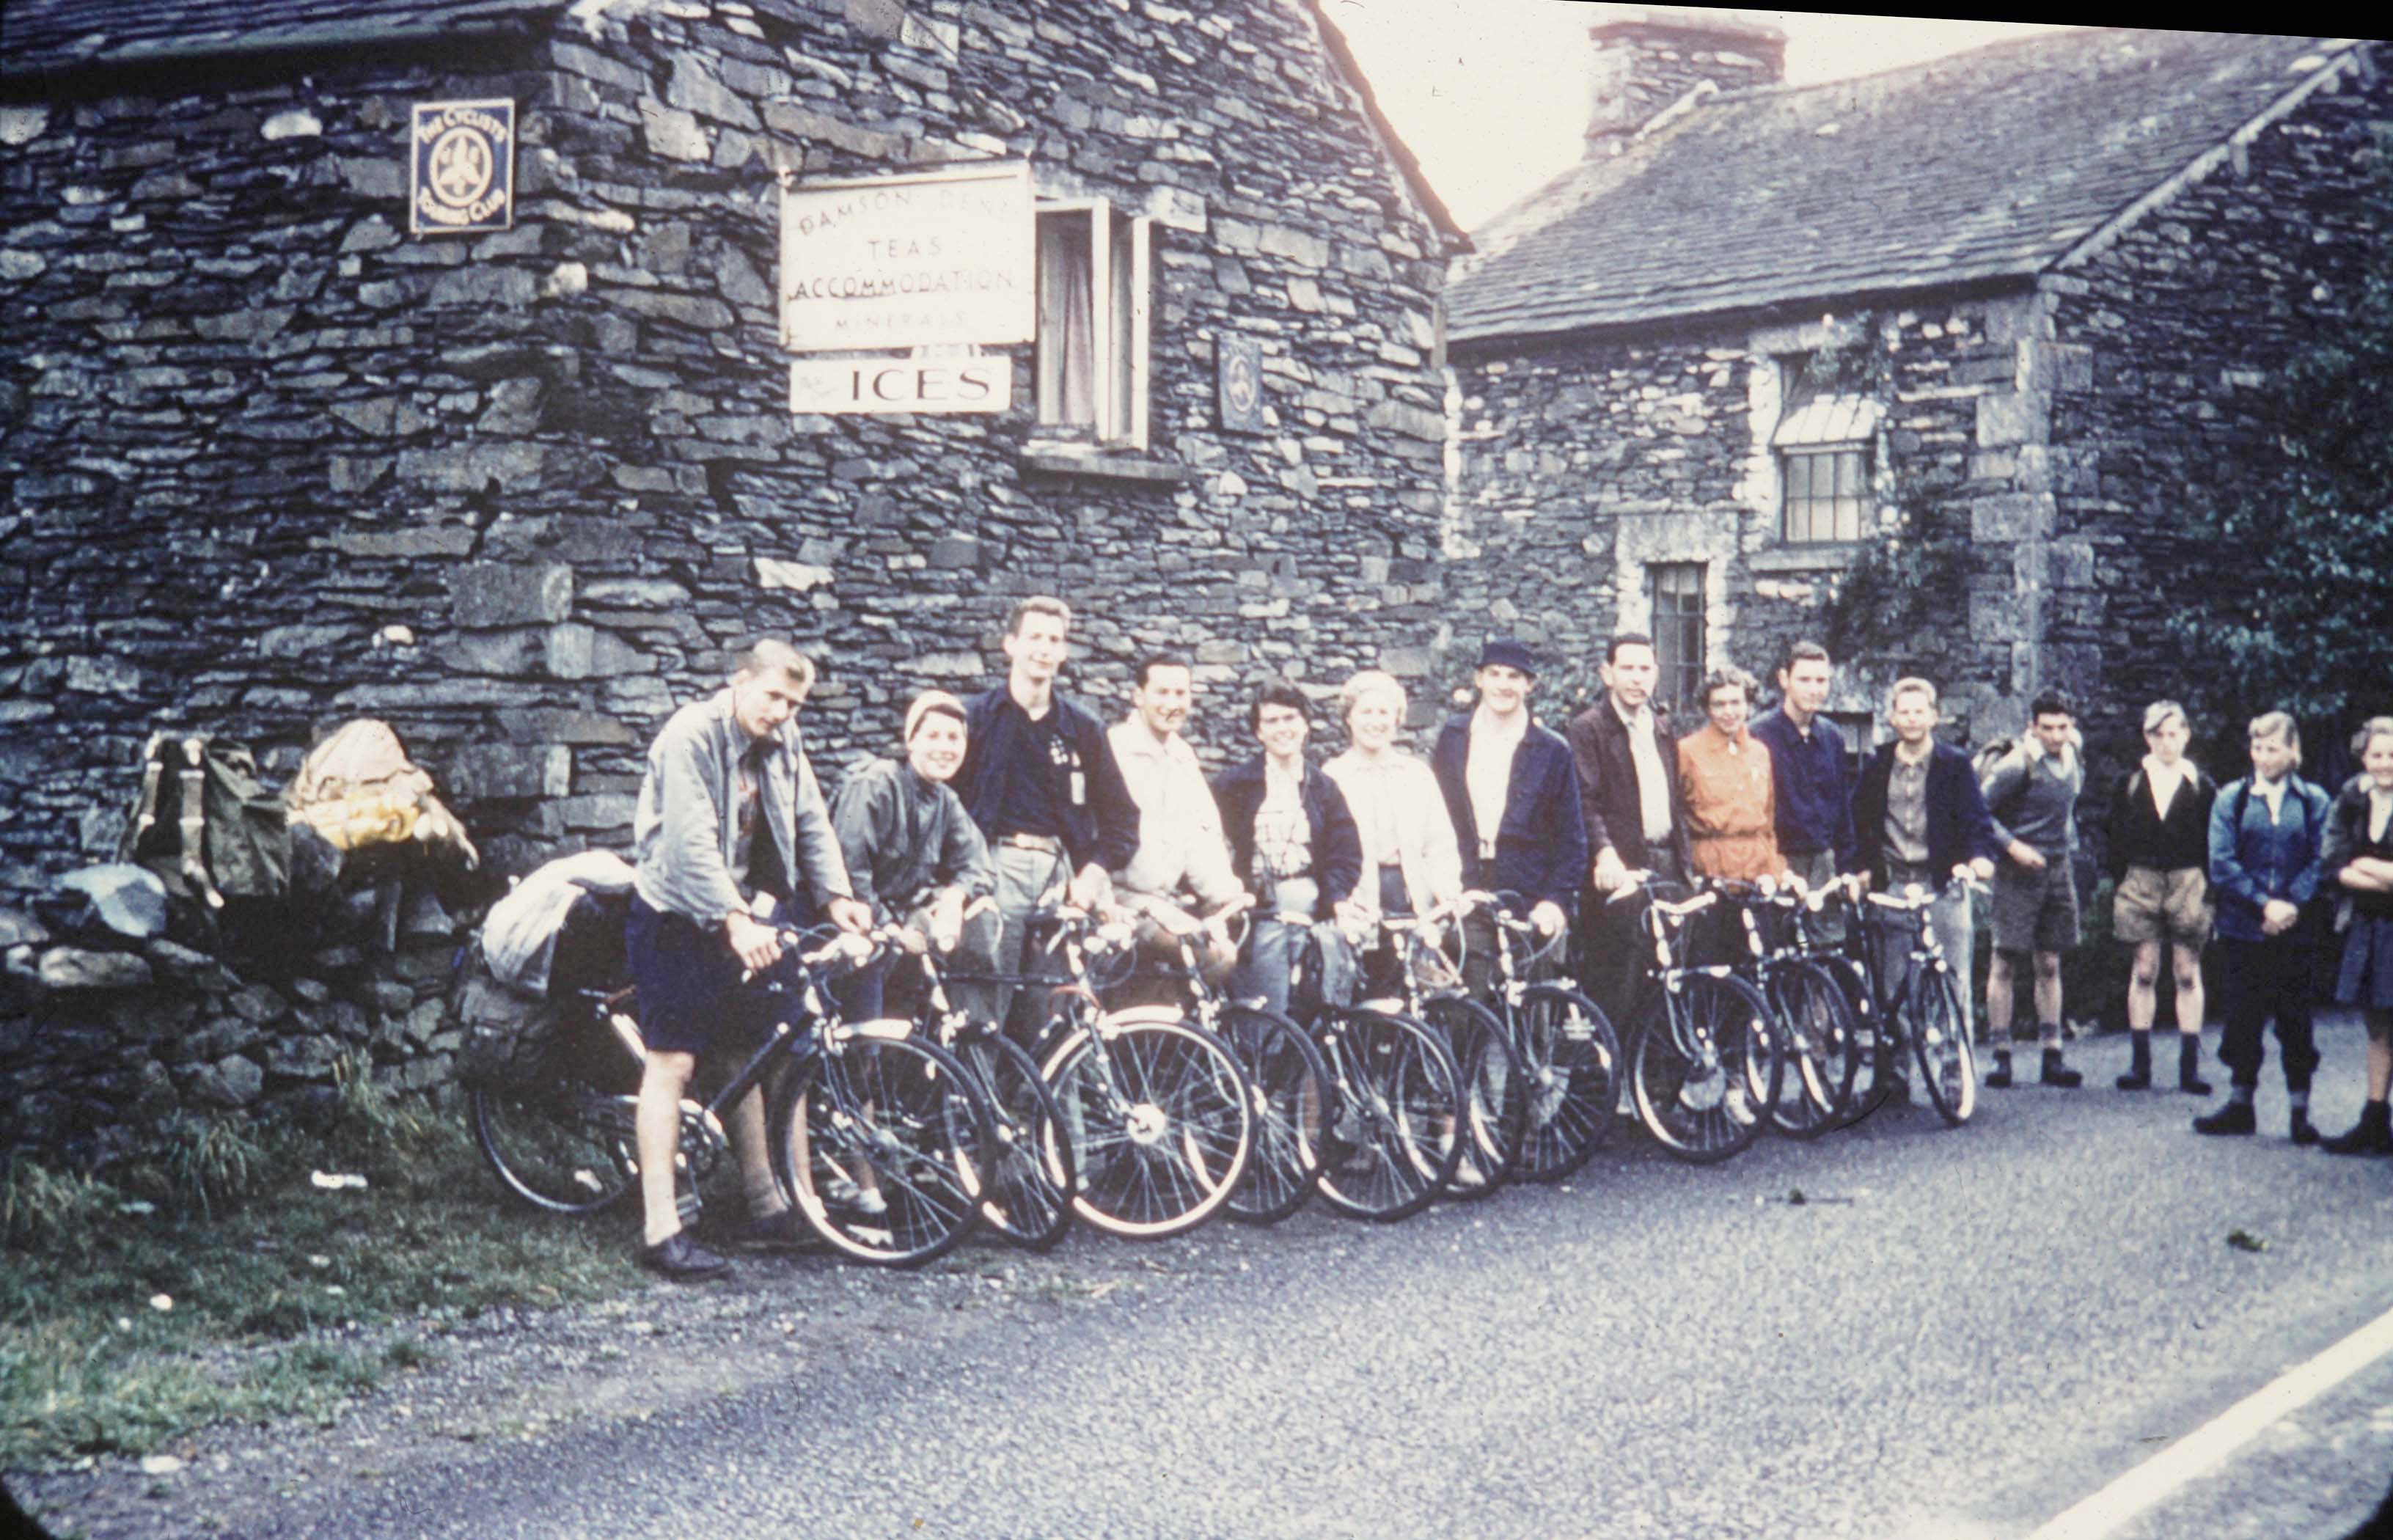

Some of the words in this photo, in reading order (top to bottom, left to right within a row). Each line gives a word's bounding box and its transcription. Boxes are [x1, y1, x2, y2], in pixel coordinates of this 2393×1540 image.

[799, 188, 912, 235] DAMSON
[867, 235, 942, 259] TEAS
[794, 269, 1014, 298] ACCOMMODATION
[852, 367, 990, 401] ICES
